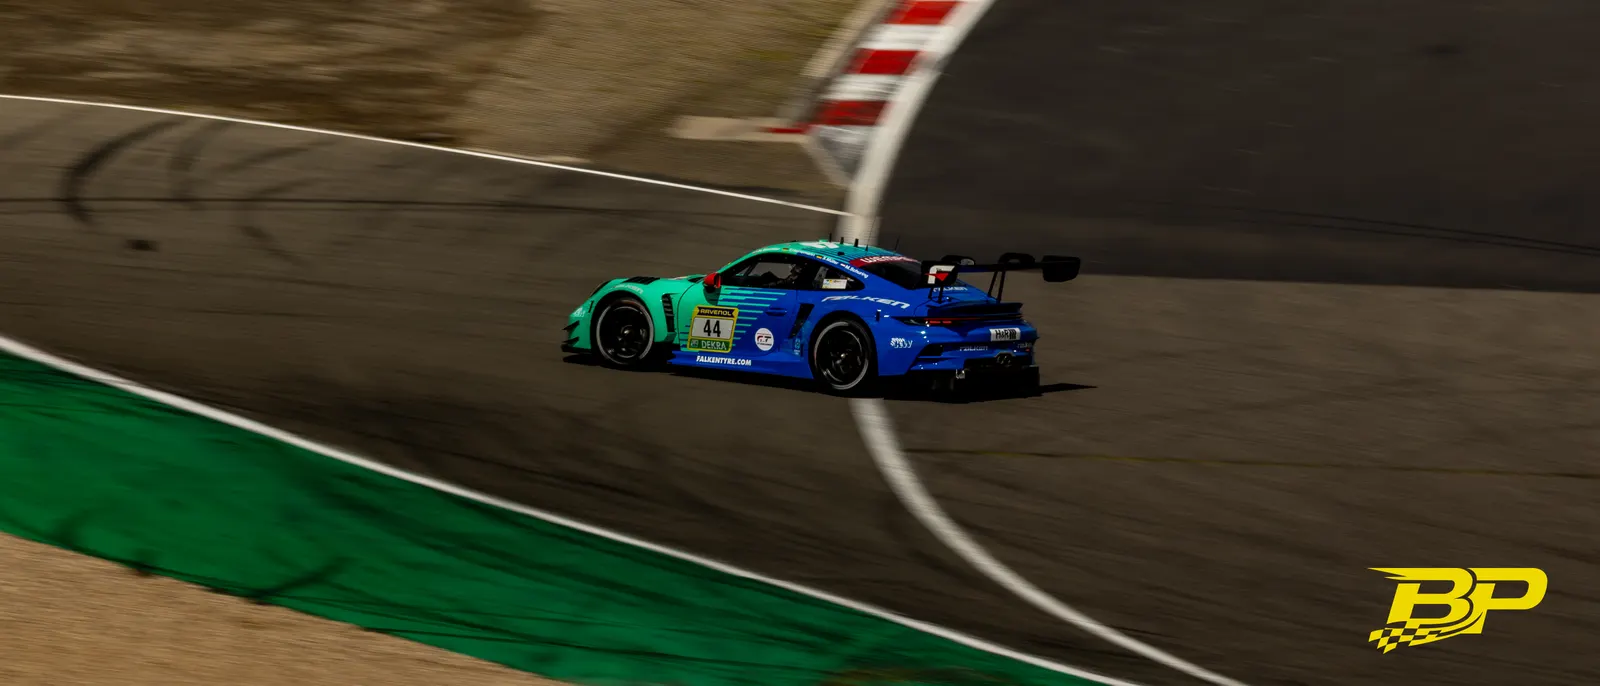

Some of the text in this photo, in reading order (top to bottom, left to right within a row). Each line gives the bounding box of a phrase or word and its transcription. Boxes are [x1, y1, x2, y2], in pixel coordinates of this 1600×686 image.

[821, 295, 911, 310] FALKEN
[700, 308, 732, 317] RAVENOL
[703, 319, 722, 338] 44
[701, 340, 728, 351] DEKRA
[696, 355, 752, 367] FALKENTYRE.COM
